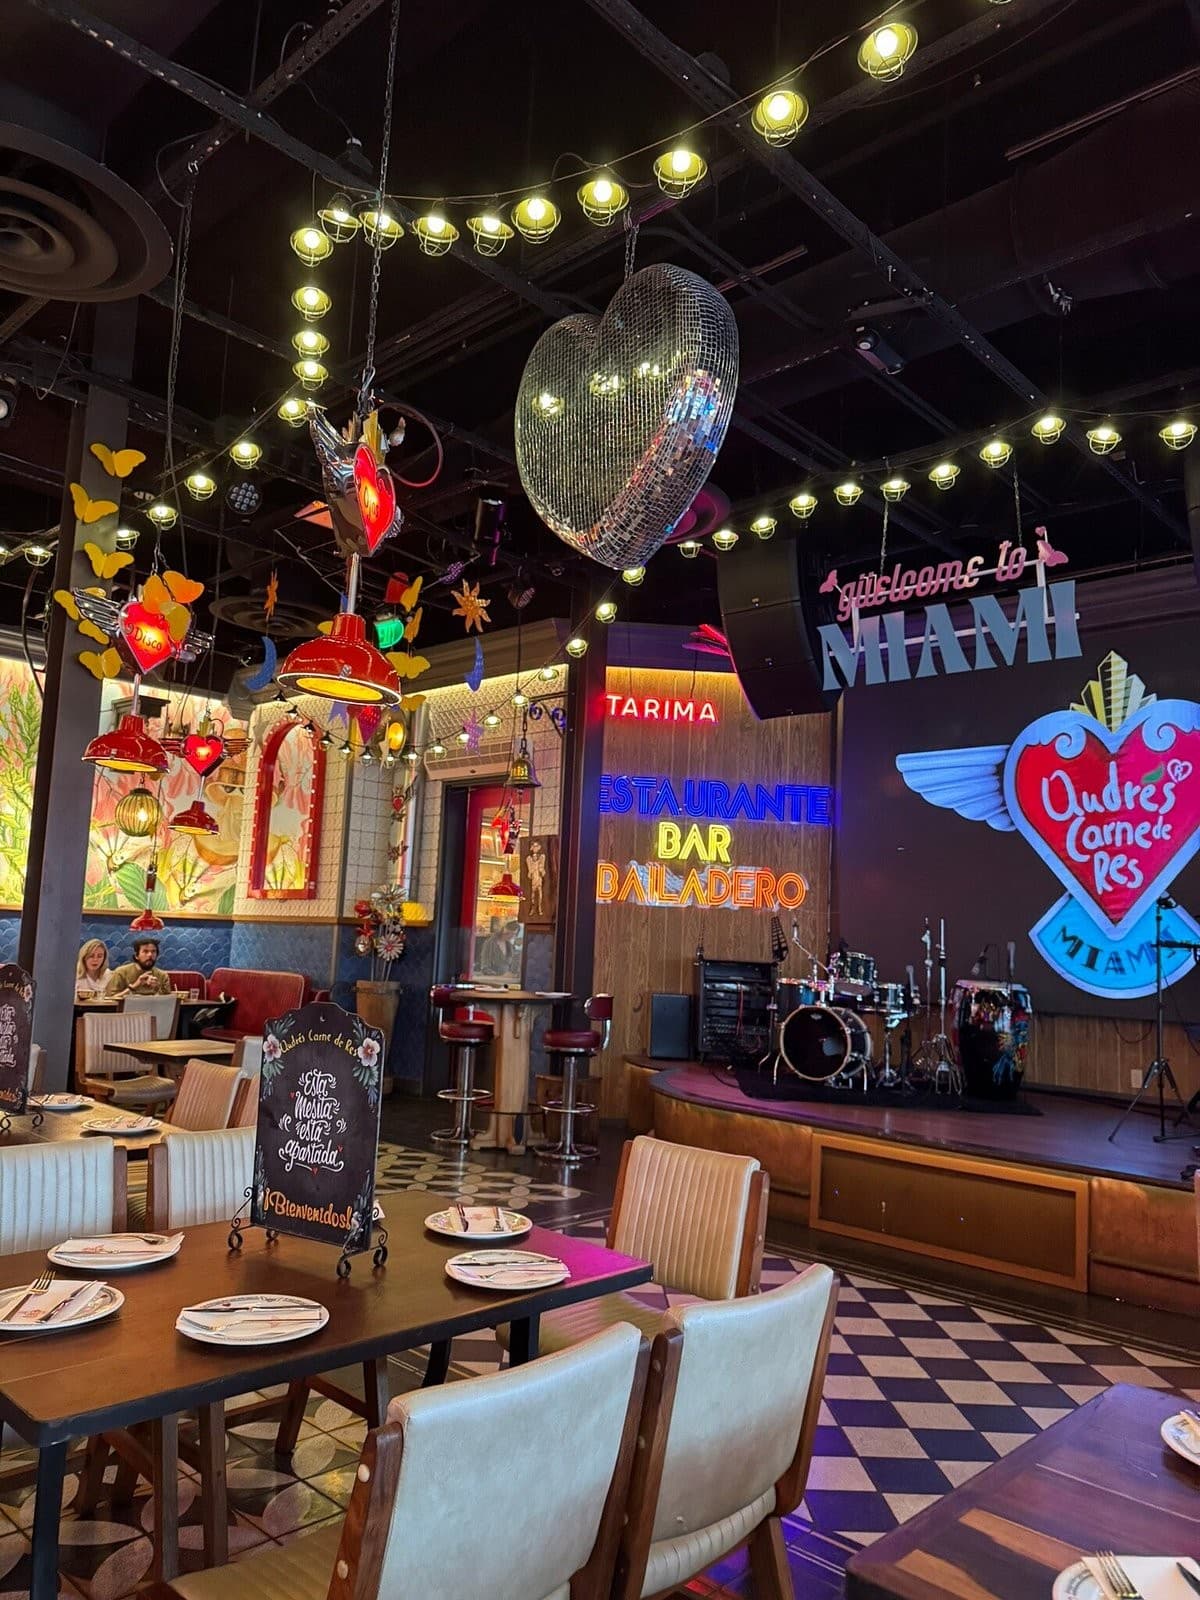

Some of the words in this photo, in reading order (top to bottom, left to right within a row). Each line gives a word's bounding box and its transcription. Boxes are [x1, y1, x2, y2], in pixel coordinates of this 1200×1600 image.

[995, 540, 1028, 582] to
[818, 579, 1083, 692] MIAMI
[605, 694, 718, 722] TARIMA
[657, 821, 732, 863] BAR
[1065, 816, 1152, 863] Carne
[1151, 815, 1173, 840] de
[596, 861, 806, 909] BAILADERO
[1093, 850, 1144, 895] Res
[303, 1068, 334, 1097] Esta
[294, 1091, 338, 1120] Mesita
[279, 1139, 344, 1172] apartada
